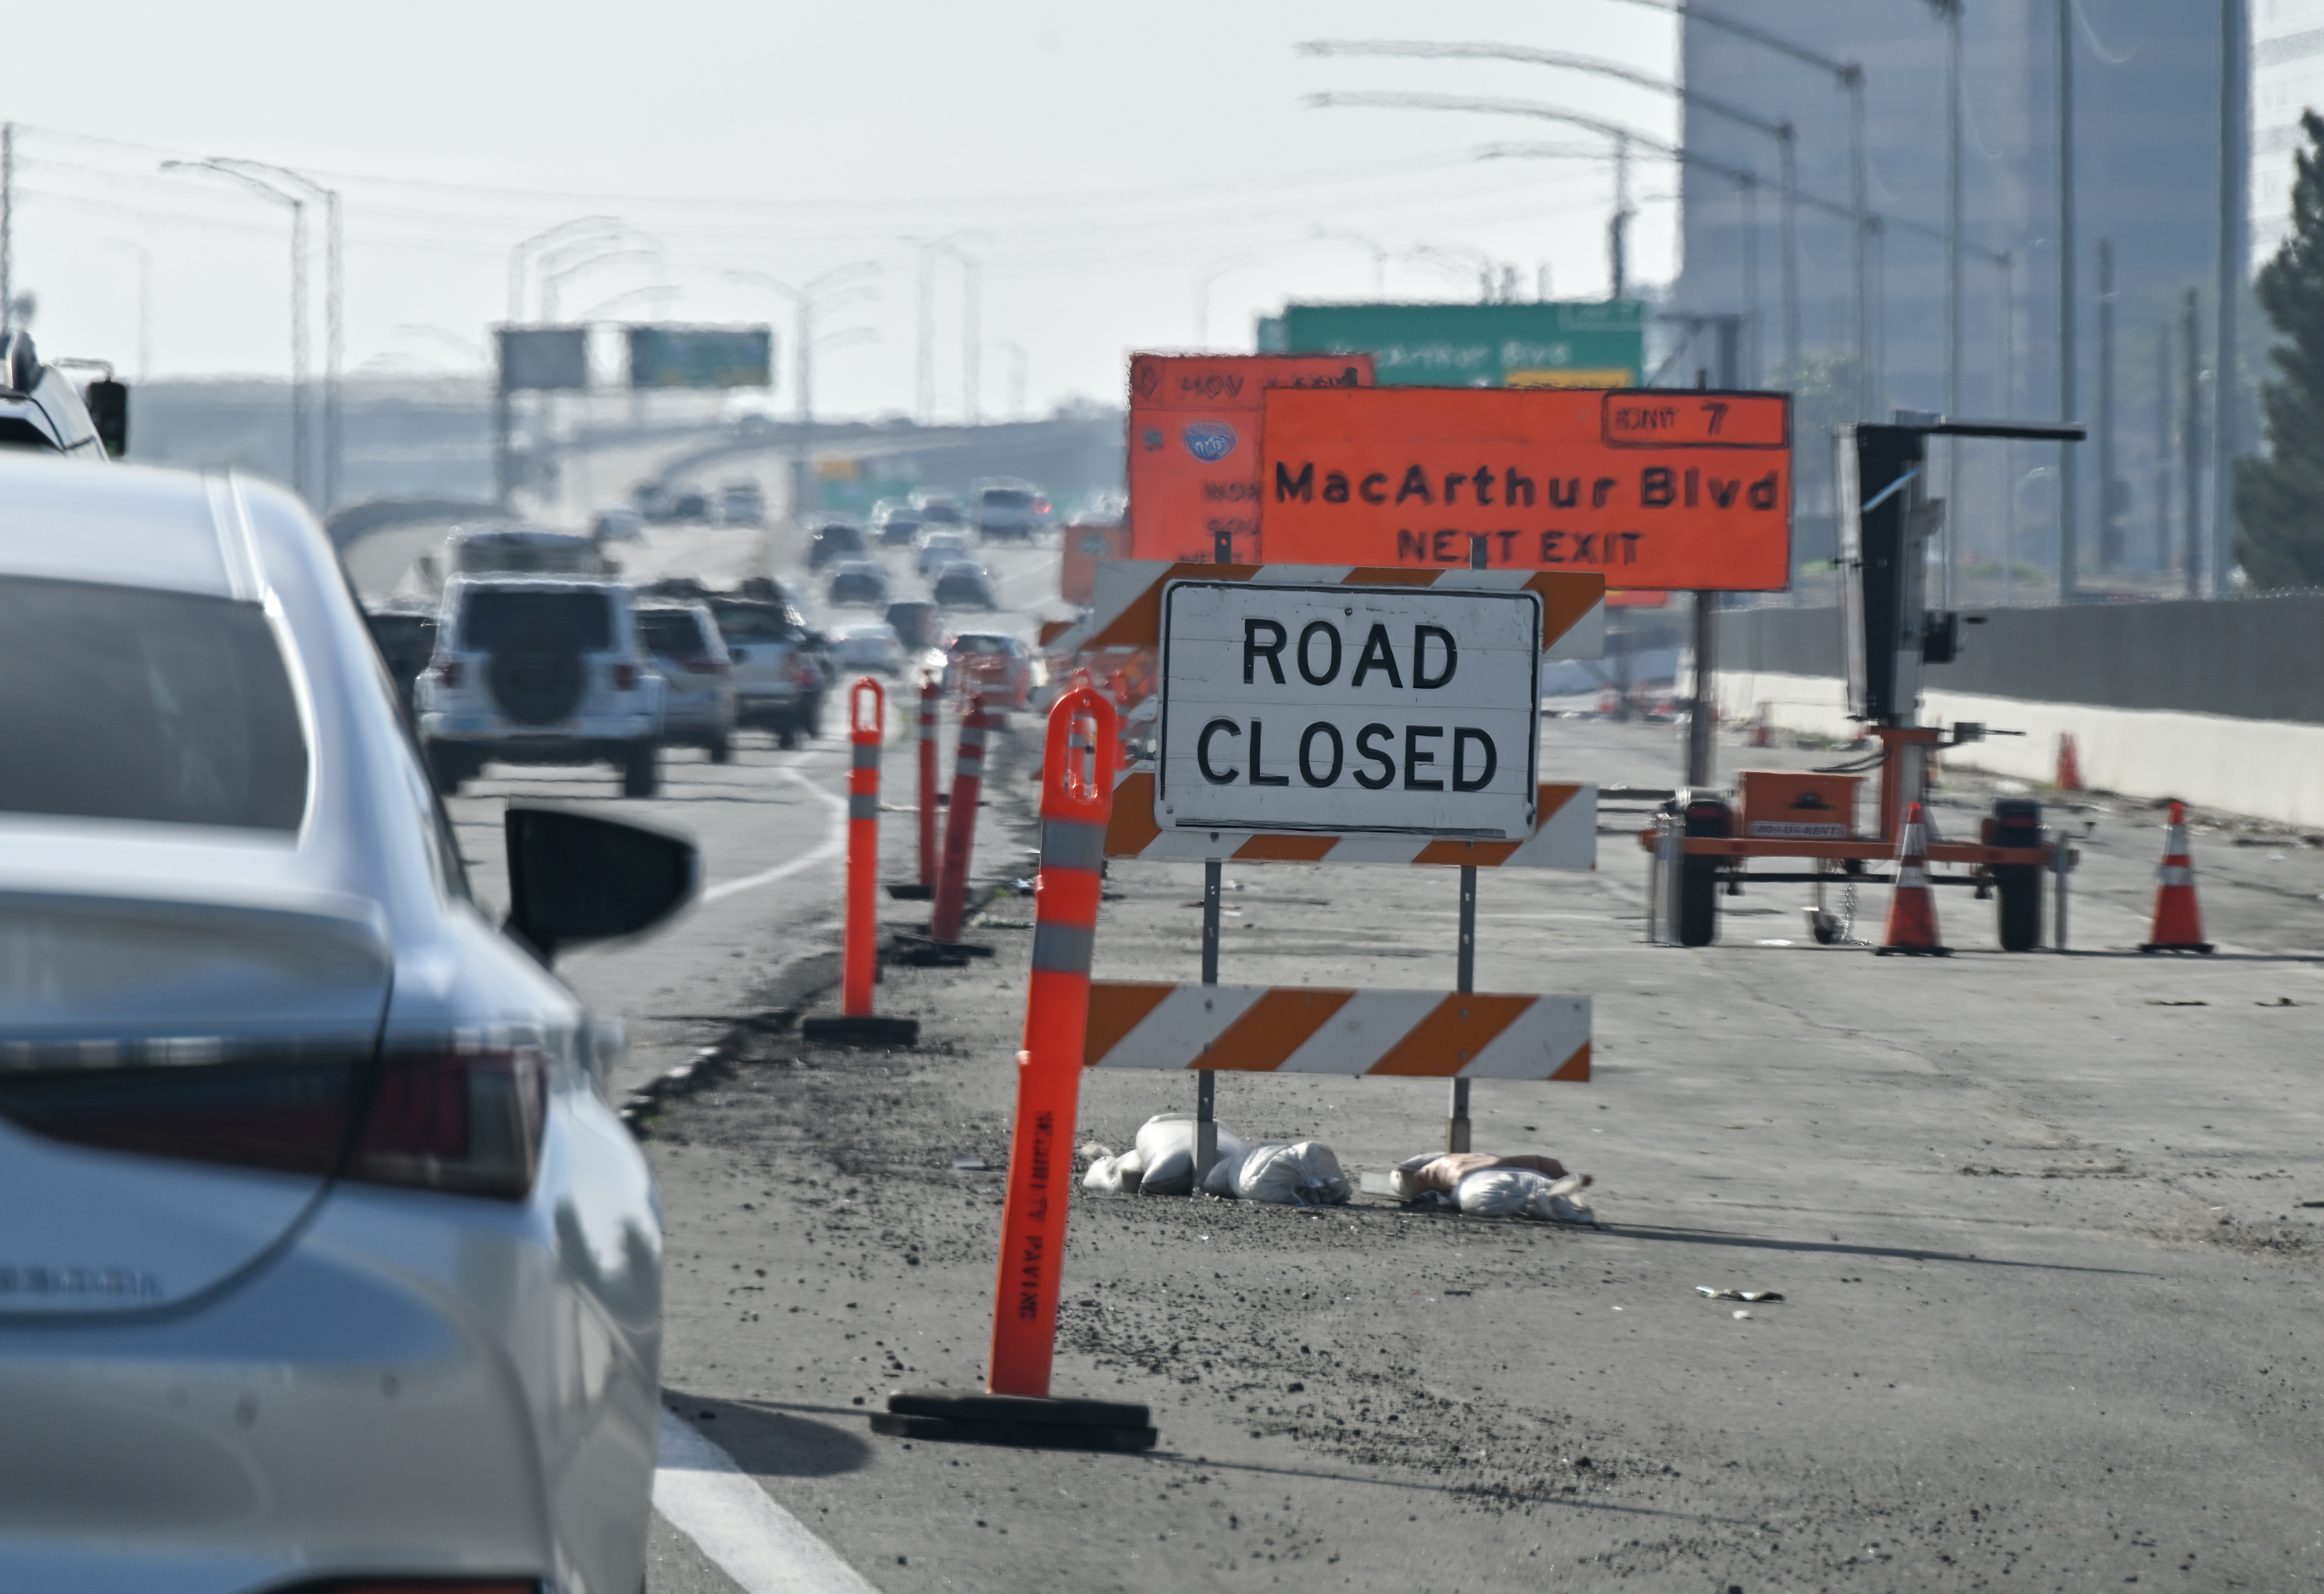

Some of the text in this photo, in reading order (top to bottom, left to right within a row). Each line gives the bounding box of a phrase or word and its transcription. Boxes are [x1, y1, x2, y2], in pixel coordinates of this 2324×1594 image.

[1700, 402, 1730, 435] 7
[1276, 462, 1617, 509] MacArthur
[1640, 467, 1780, 511] Blvd
[1540, 530, 1642, 566] EXIT
[1243, 618, 1458, 689] ROAD
[1197, 718, 1498, 791] CLOSED
[1018, 1234, 1045, 1321] PAVING
